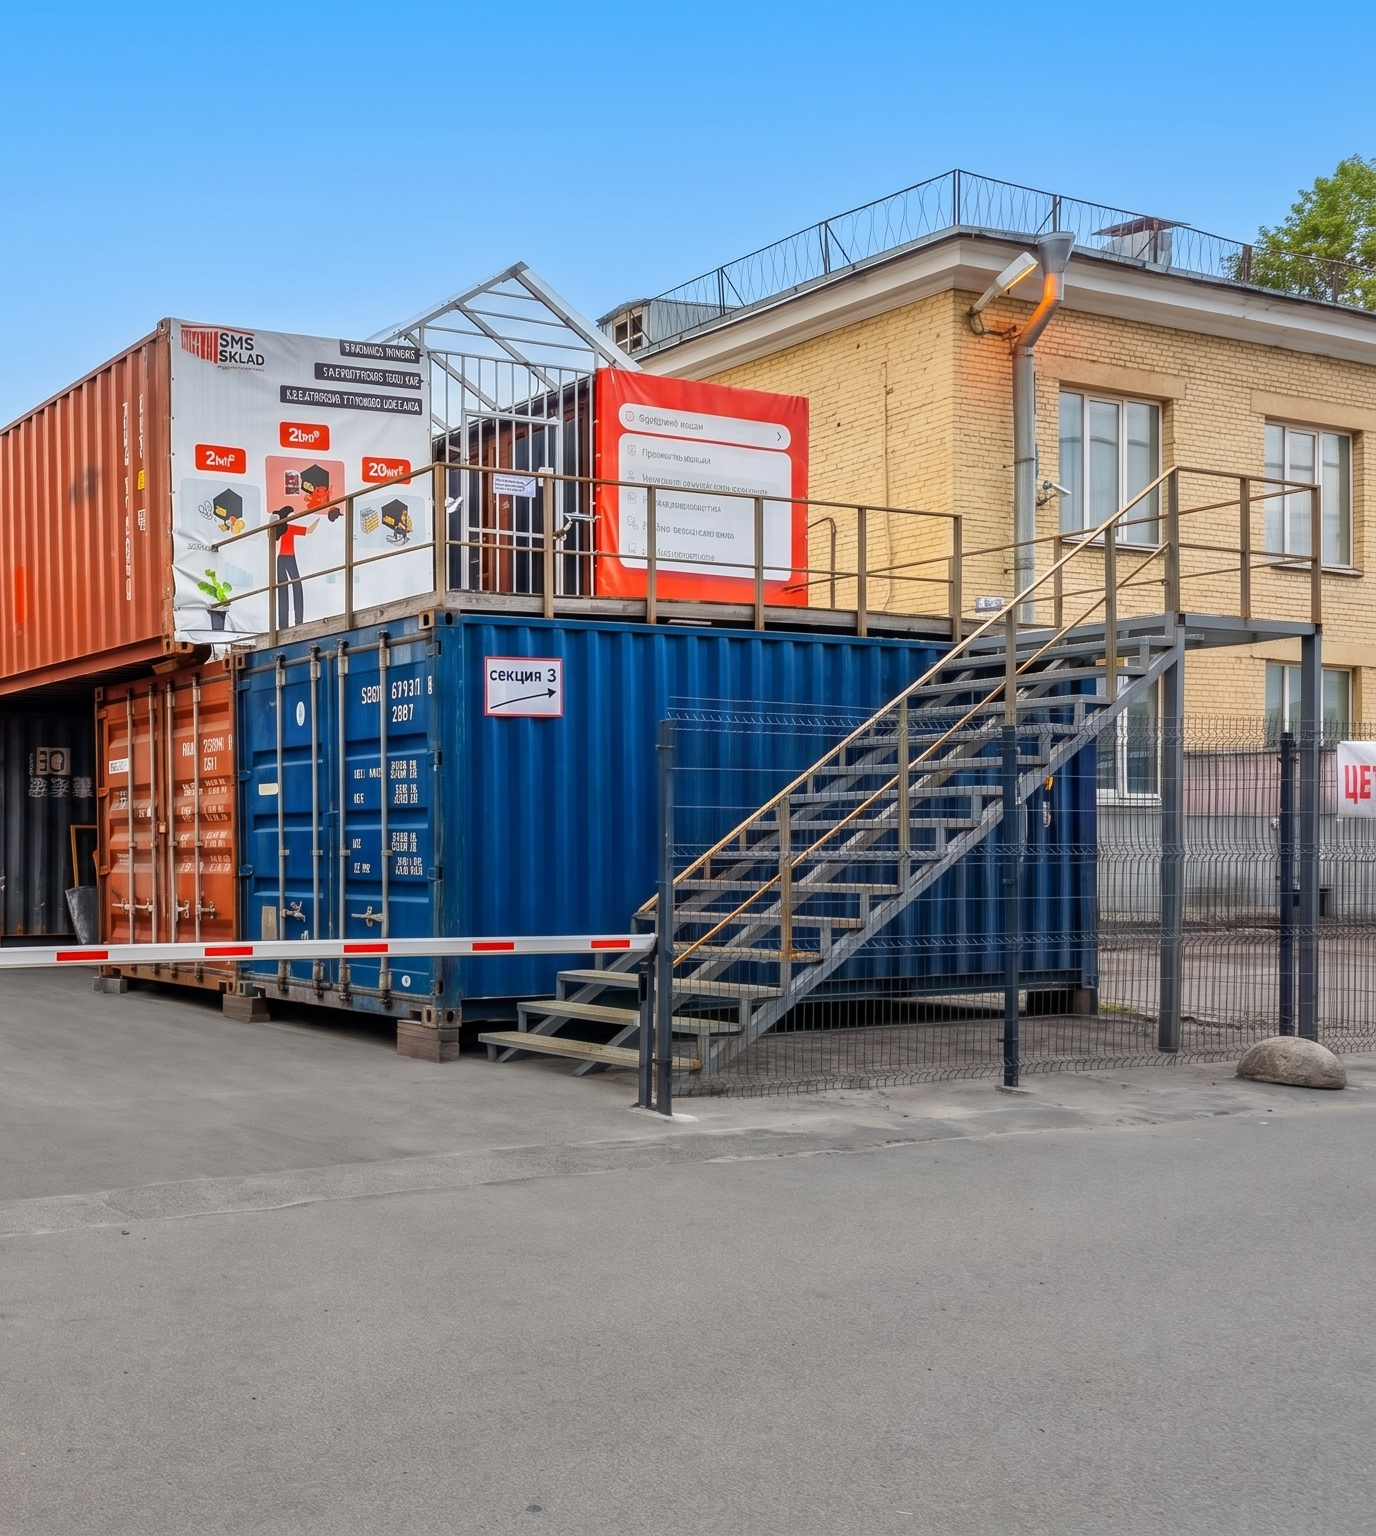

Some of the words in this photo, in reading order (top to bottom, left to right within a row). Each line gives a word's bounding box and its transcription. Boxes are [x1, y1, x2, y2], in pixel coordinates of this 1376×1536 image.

[219, 332, 254, 351] SMS
[219, 349, 265, 366] SKLAD
[489, 669, 542, 684] секция
[547, 668, 557, 683] 3
[1344, 764, 1376, 805] ЦЕ
